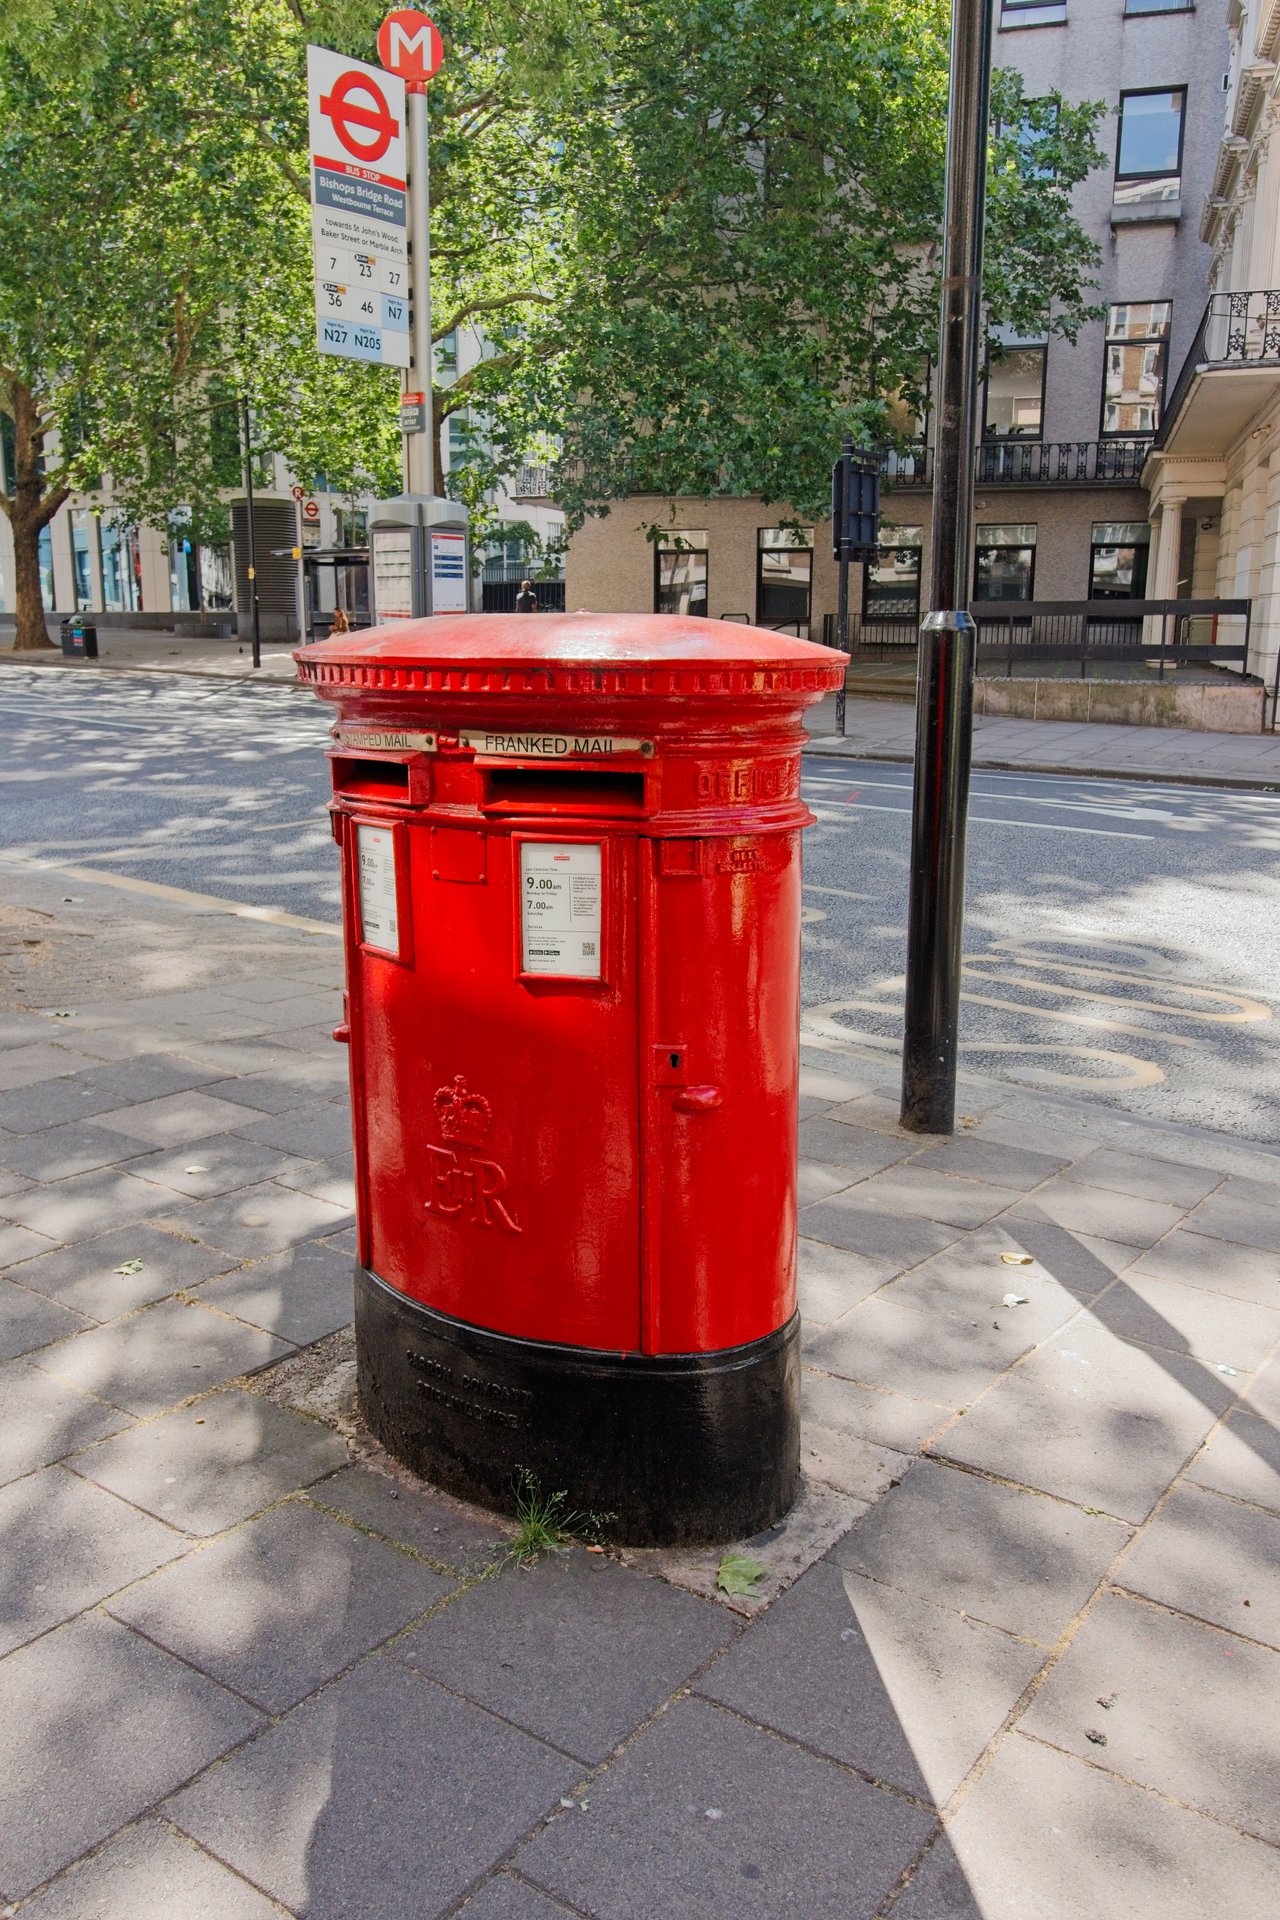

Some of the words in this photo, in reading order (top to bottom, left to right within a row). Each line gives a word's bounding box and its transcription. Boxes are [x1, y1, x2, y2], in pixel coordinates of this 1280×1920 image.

[389, 21, 432, 72] M
[345, 165, 360, 176] BUS
[362, 170, 380, 181] STOP
[320, 176, 355, 194] Bishops
[357, 186, 382, 203] Bridge
[384, 194, 403, 208] Road
[332, 193, 371, 211] Westbourne
[373, 204, 394, 217] Terrace
[326, 218, 352, 230] towards
[361, 226, 380, 237] John's
[321, 228, 339, 239] Baker
[341, 233, 360, 244] Street
[370, 240, 389, 252] Marble
[391, 246, 403, 255] Arch
[330, 257, 337, 270] 7
[360, 264, 372, 278] 23
[389, 271, 400, 285] 27
[328, 293, 342, 307] 36
[361, 301, 373, 314] 46
[388, 306, 402, 320] N7
[324, 328, 348, 343] N27
[354, 334, 381, 350] N205
[295, 488, 301, 498] R
[385, 734, 412, 748] MAIL
[485, 735, 568, 754] FRANKED
[574, 738, 614, 754] MAIL
[526, 877, 562, 890] 9.00am
[527, 900, 553, 910] 7.00am
